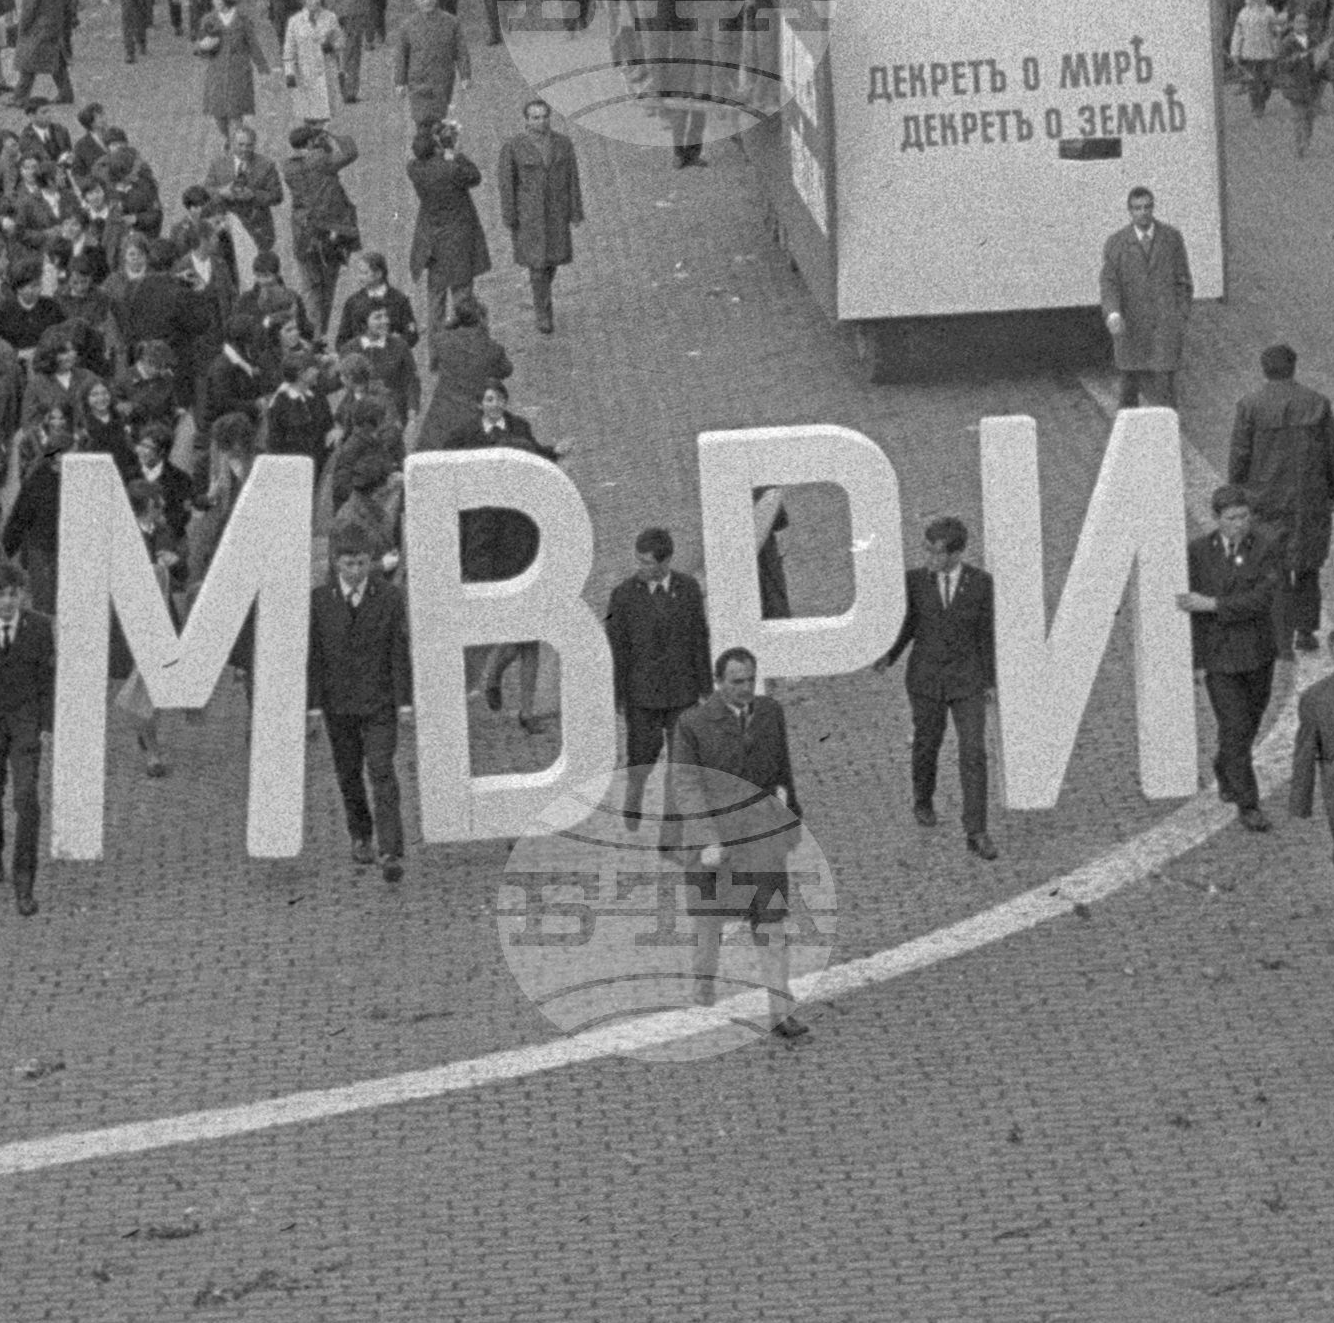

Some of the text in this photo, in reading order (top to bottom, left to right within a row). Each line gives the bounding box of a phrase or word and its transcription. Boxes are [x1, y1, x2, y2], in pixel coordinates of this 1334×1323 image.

[868, 58, 1007, 103] ДЕКРЕТЪ
[1022, 56, 1042, 92] О
[900, 107, 1034, 153] ДЕКРЕТЪ
[1044, 106, 1063, 140] О
